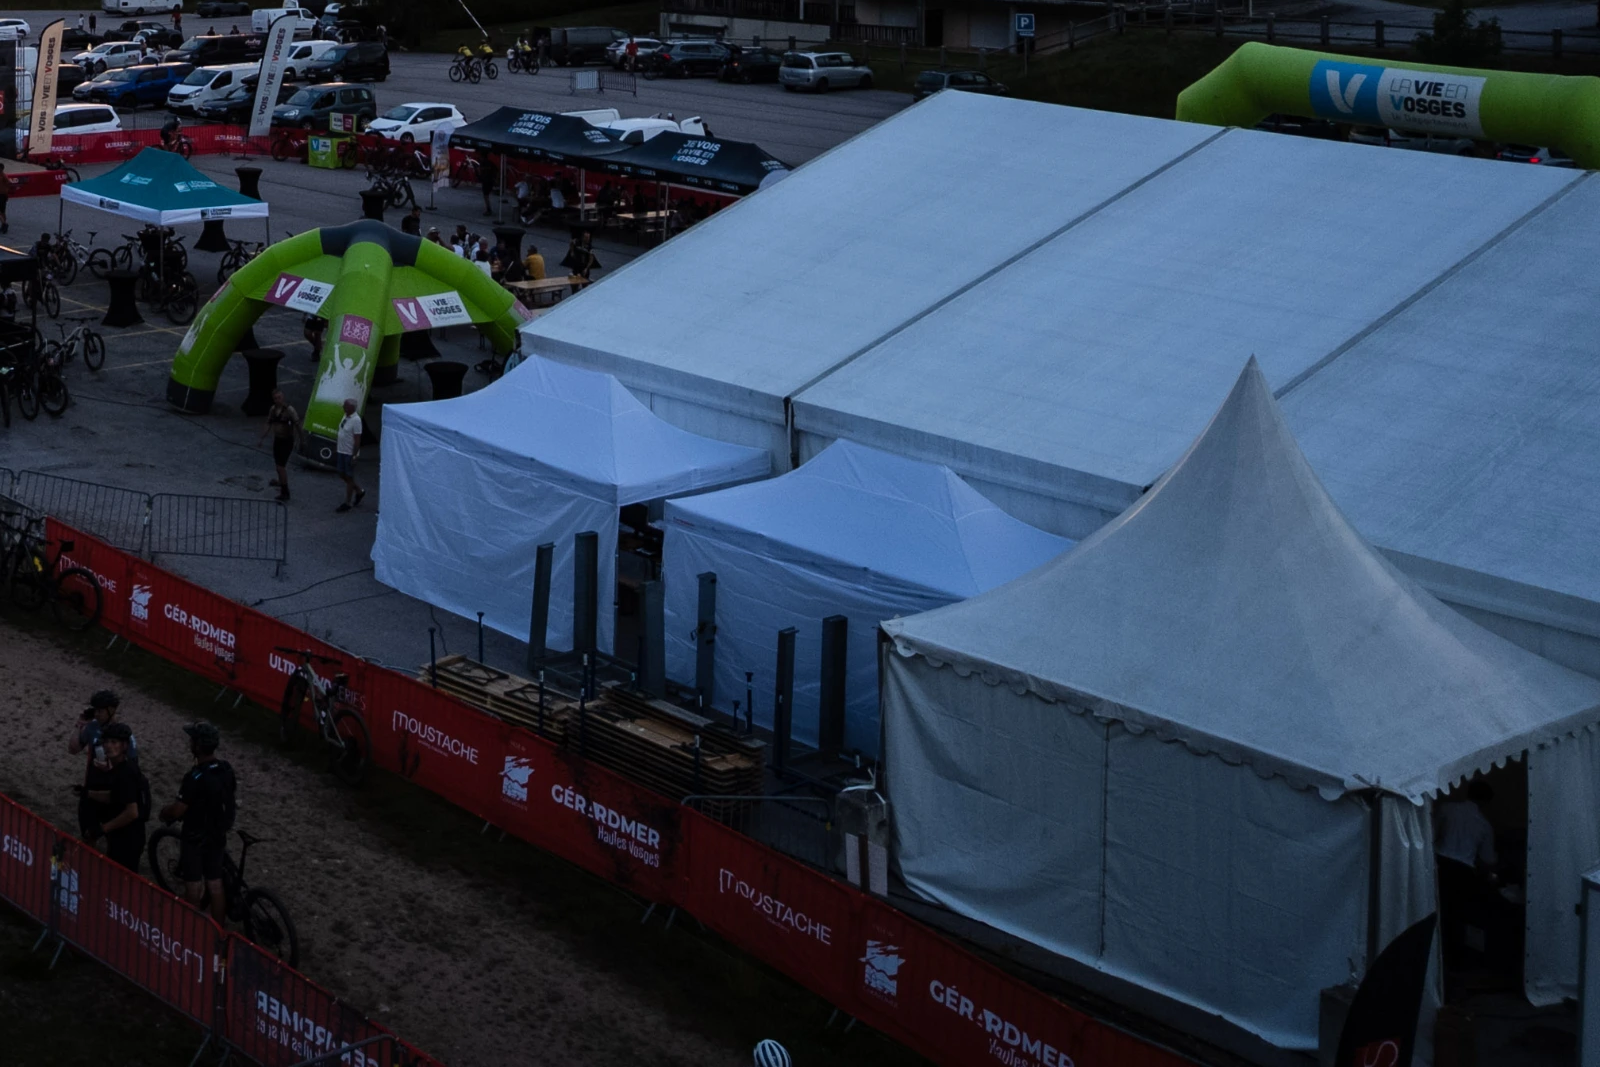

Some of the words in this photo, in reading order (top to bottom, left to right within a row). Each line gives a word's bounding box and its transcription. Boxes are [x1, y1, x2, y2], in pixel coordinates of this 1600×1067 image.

[1021, 17, 1030, 28] P
[45, 37, 56, 74] VOSGES
[258, 96, 269, 116] VOIS
[266, 72, 276, 86] VIE
[272, 28, 286, 62] VOSGES
[42, 84, 51, 99] VIE
[1414, 80, 1445, 97] VIE
[1390, 94, 1466, 118] VOSGES
[38, 111, 47, 132] VOIS
[529, 113, 552, 124] VOIS
[696, 140, 722, 152] VOIS
[309, 285, 321, 293] VIE
[297, 291, 324, 304] VOSGES
[433, 298, 448, 306] VIE
[429, 305, 462, 316] VOSGES
[392, 710, 479, 765] MOUSTACHE
[551, 784, 660, 850] GÉRARDMER
[718, 868, 832, 946] MOUSTACHE
